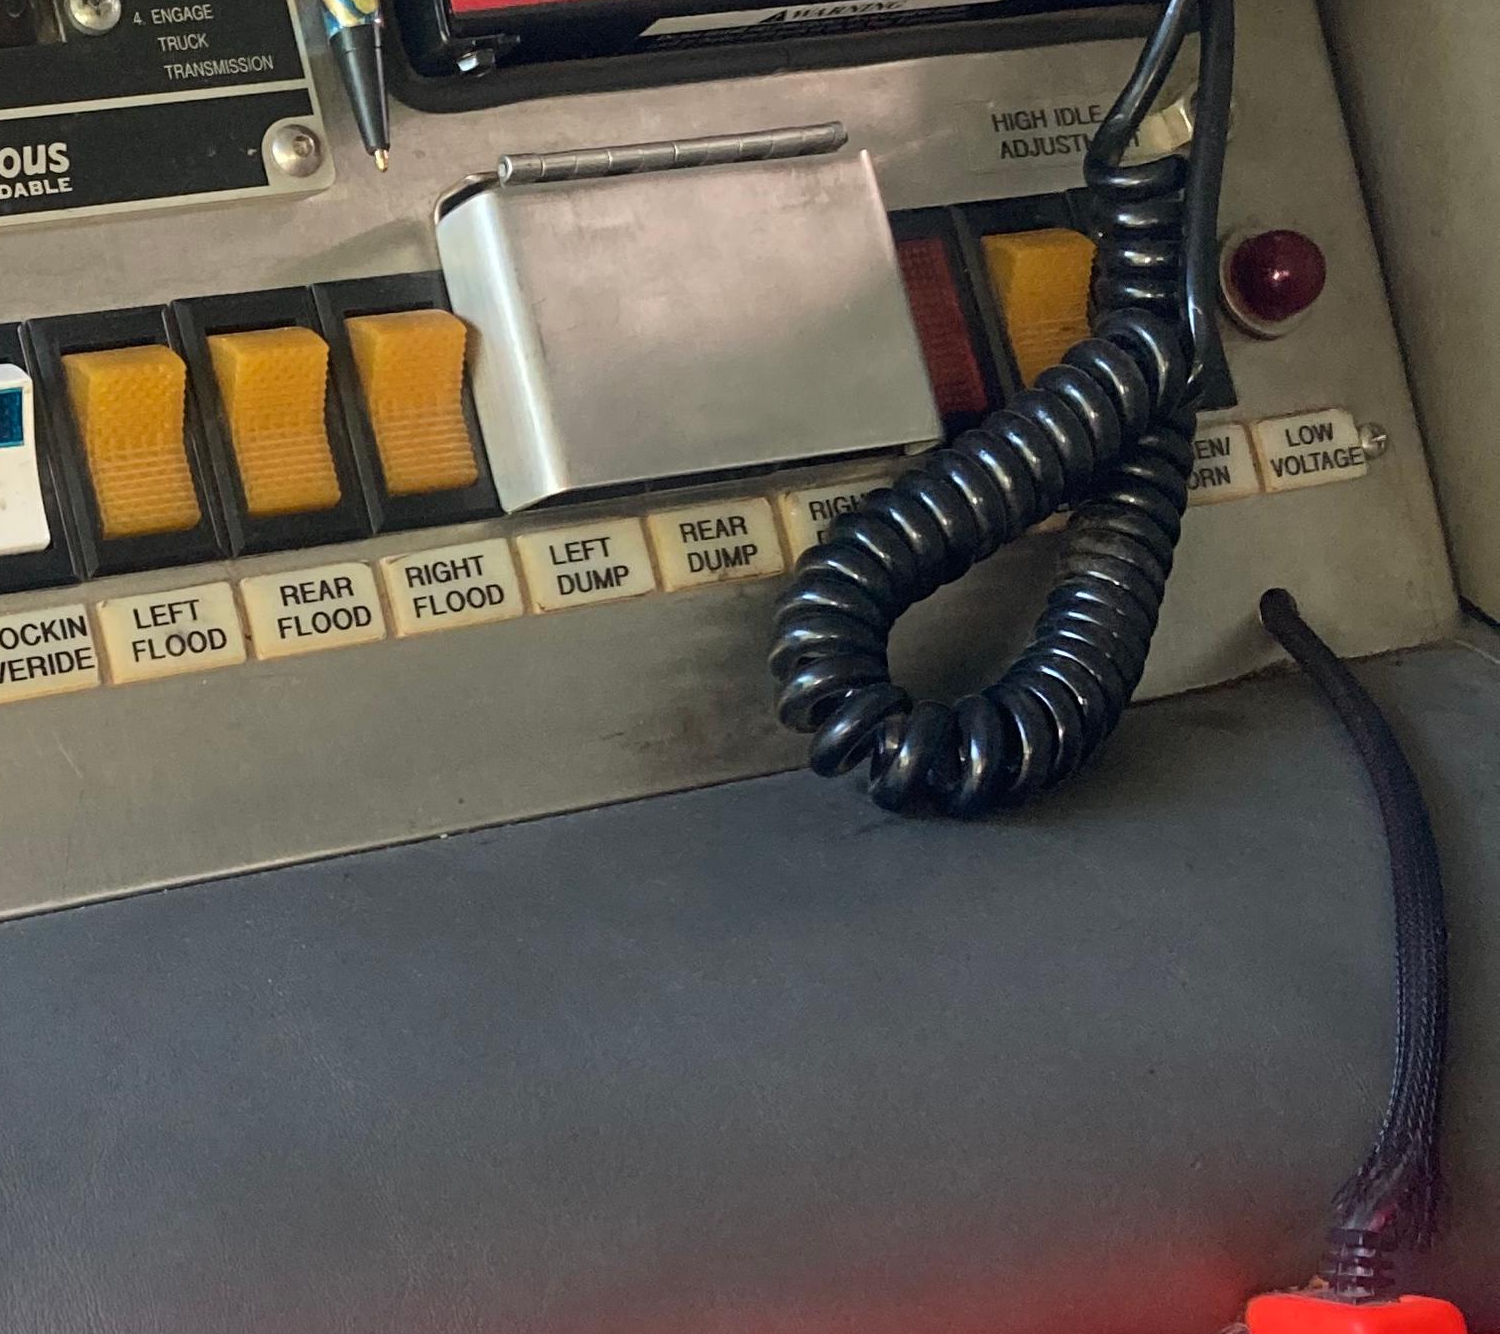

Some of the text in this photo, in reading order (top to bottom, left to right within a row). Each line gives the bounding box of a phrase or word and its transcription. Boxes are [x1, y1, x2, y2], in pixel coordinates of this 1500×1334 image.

[152, 5, 213, 24] ENGAGE
[787, 0, 909, 22] WARNING
[158, 34, 208, 51] TRUCK
[164, 56, 273, 80] TRANSMISSION
[991, 104, 1105, 133] HIGH IDLE
[1194, 437, 1230, 459] EN/
[1285, 423, 1334, 447] LOW
[1270, 447, 1364, 477] VOLTAGE
[1188, 466, 1230, 490] ORN
[808, 492, 866, 521] RIGH
[680, 516, 748, 543] REAR
[550, 537, 611, 565] LEFT
[687, 543, 758, 573] DUMP
[404, 555, 484, 588] RIGHT
[557, 565, 629, 595] DUMP
[279, 577, 354, 607] REAR
[412, 583, 505, 619] FLOOD
[133, 599, 200, 630] LEFT
[277, 605, 372, 639] FLOOD
[131, 627, 228, 663] FLOOD
